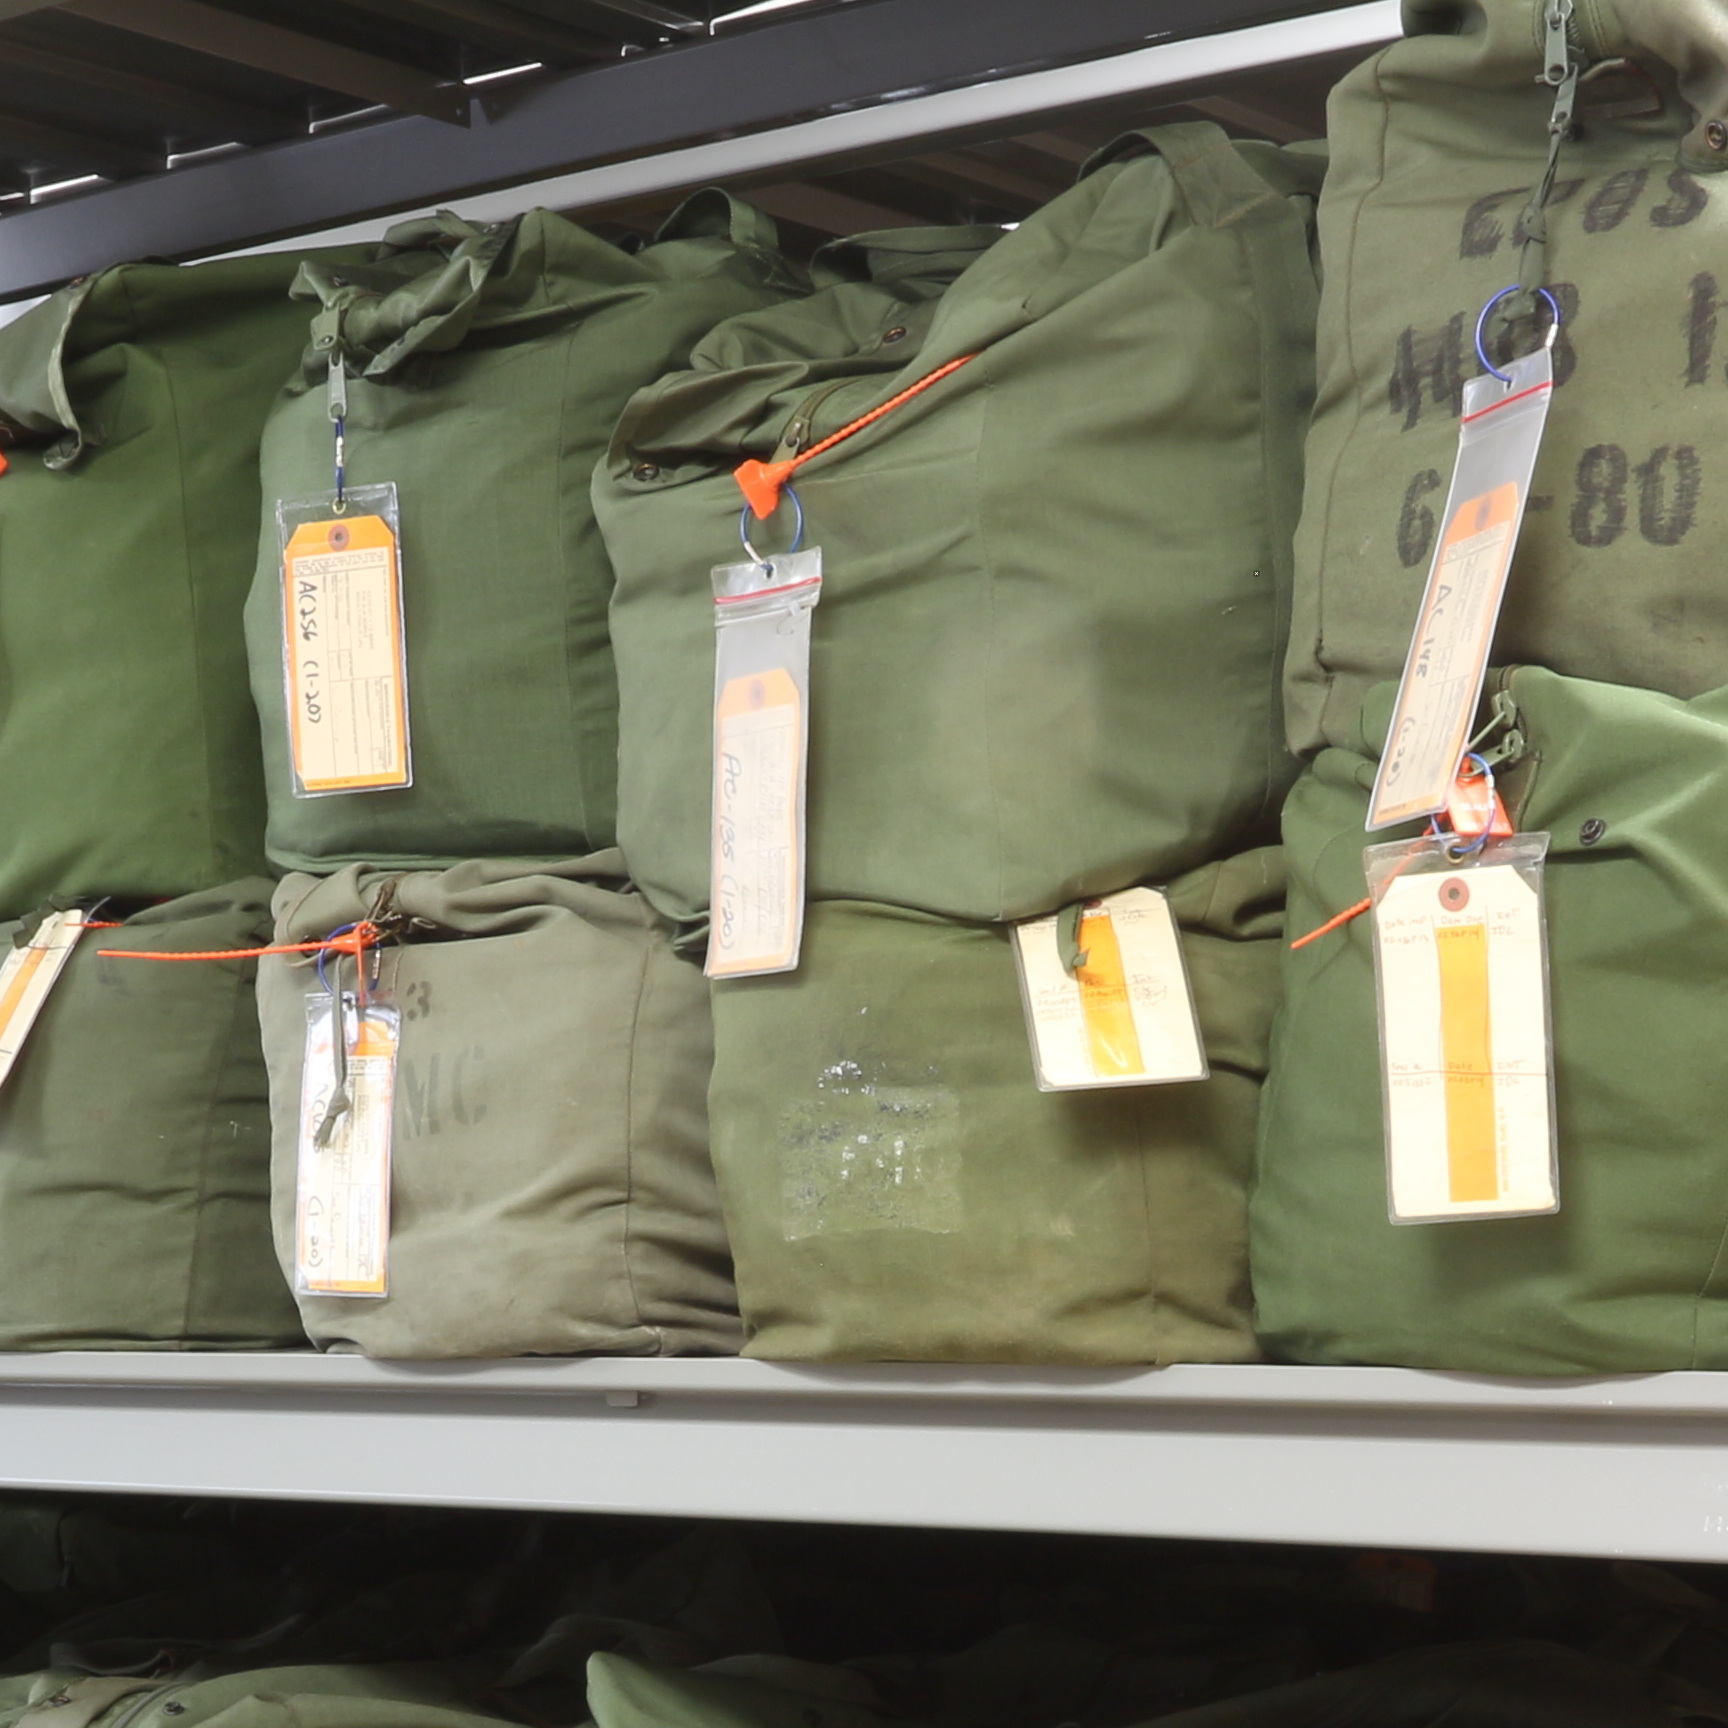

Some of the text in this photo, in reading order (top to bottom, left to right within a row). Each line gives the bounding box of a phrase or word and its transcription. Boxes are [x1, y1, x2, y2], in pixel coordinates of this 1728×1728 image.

[298, 580, 318, 642] AC256
[718, 752, 742, 951] AC-135 (1-20)
[307, 1195, 325, 1269] (1-20)
